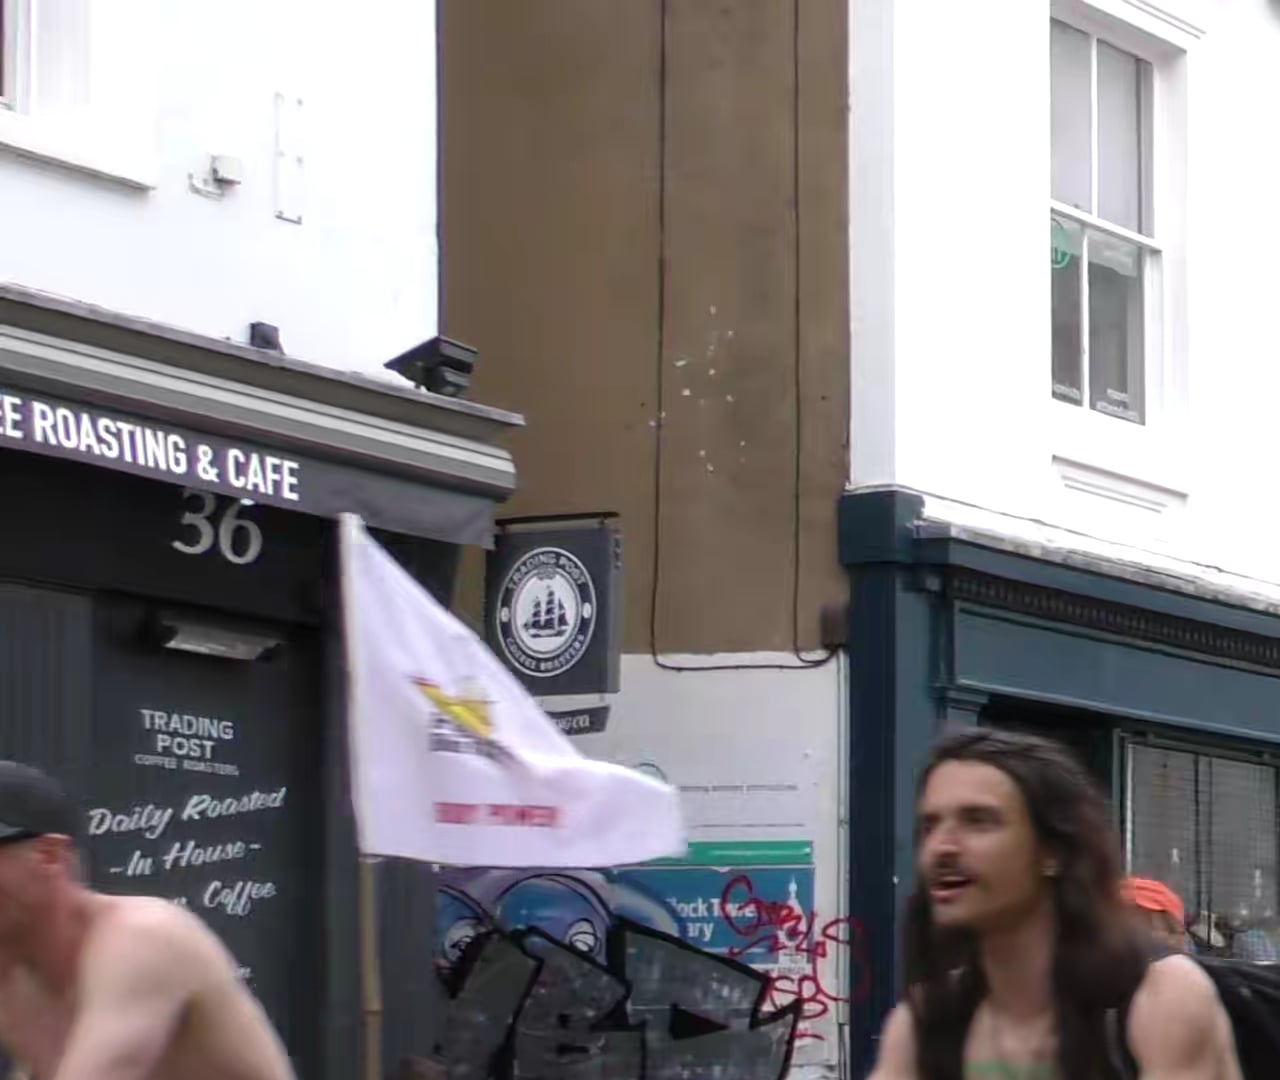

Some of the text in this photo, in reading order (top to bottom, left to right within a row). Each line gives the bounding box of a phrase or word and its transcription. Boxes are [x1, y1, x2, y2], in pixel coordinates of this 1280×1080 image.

[0, 395, 299, 500] E ROASTING & CAFE
[171, 488, 263, 565] 36
[508, 551, 586, 591] TRADING POST
[138, 708, 234, 740] TRADING
[156, 734, 215, 759] POST
[88, 786, 287, 840] Daily Roasted
[203, 880, 277, 916] Coffee
